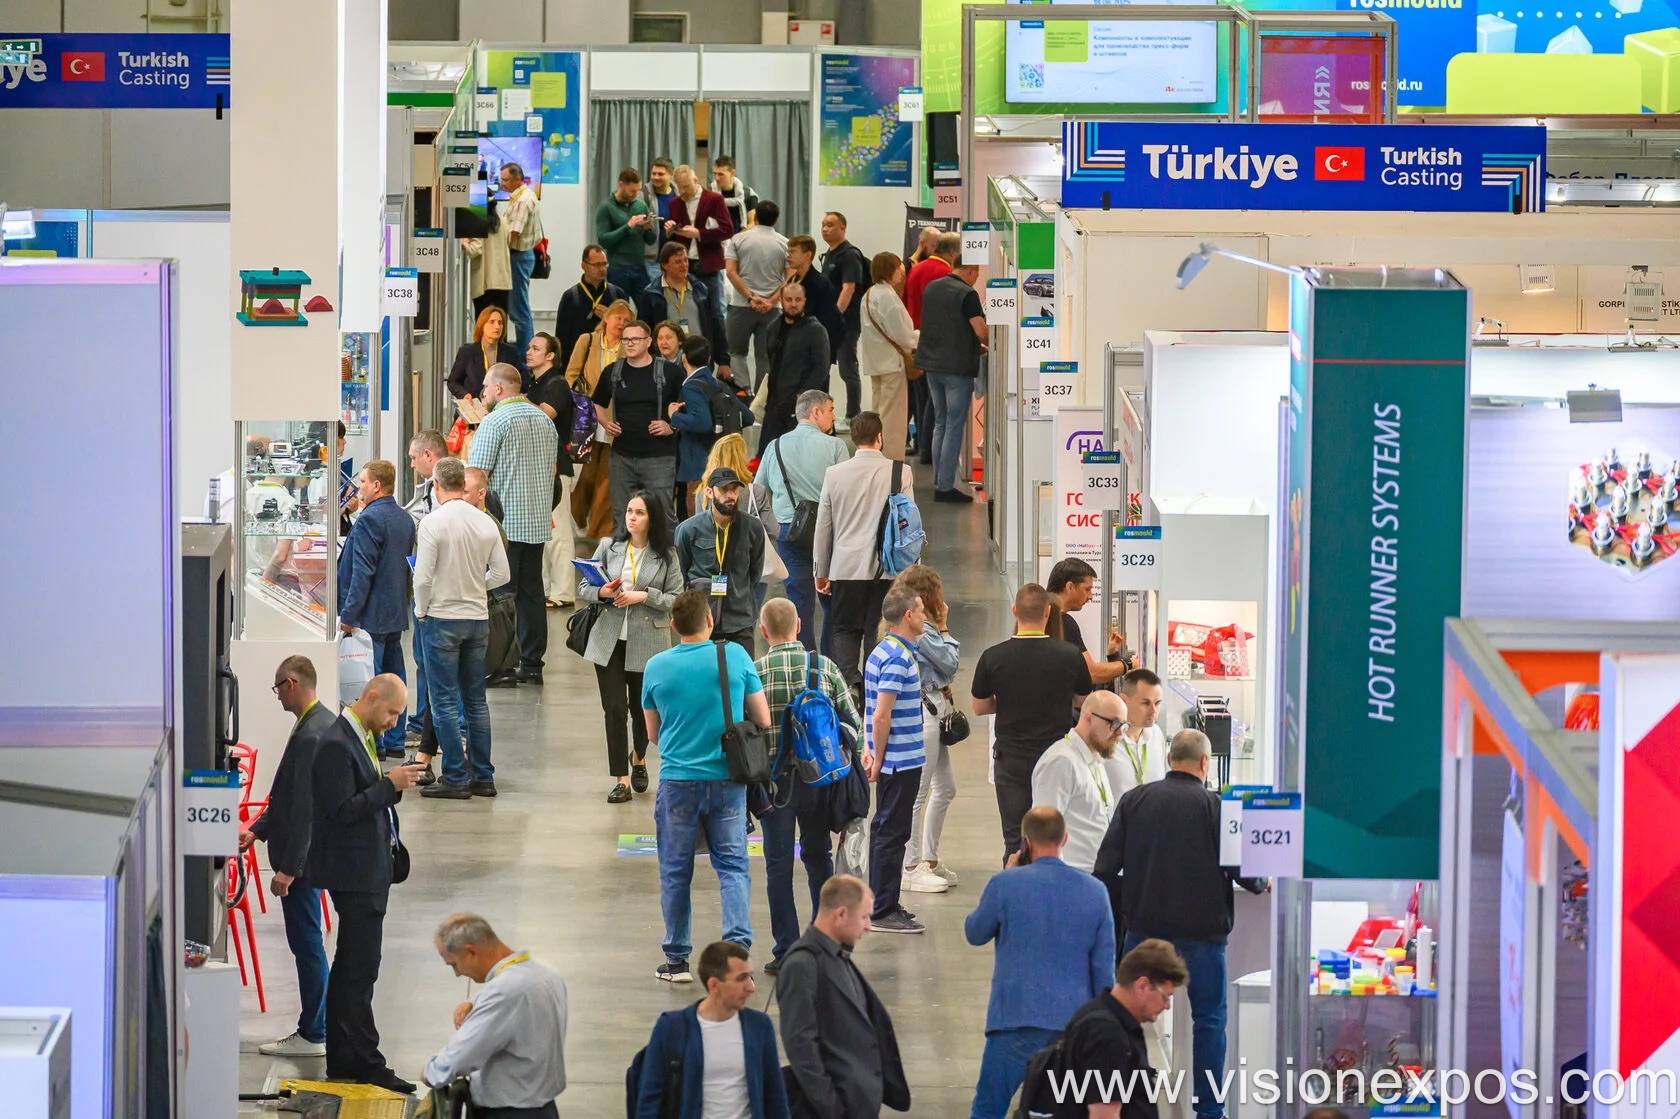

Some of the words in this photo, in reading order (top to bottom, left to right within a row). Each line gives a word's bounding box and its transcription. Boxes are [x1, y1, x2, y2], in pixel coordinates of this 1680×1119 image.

[118, 51, 190, 68] Turkish
[0, 59, 48, 90] ye
[119, 69, 191, 90] Casting
[1380, 146, 1463, 166] Turkish
[1142, 144, 1299, 189] Türkiye
[1381, 167, 1463, 191] Casting
[445, 184, 467, 193] 3C52
[938, 195, 958, 204] 3C51
[416, 247, 440, 257] 3C48
[965, 240, 988, 250] 3C47
[387, 288, 413, 299] 3C38
[990, 299, 1015, 309] 3C45
[1026, 339, 1052, 350] 3C41
[1044, 385, 1072, 396] 3C37
[1371, 403, 1402, 531] SYSTEMS
[1087, 477, 1119, 489] 3C33
[1121, 554, 1155, 567] 3C29
[1369, 535, 1399, 655] RUNNER
[1368, 657, 1396, 722] HOT
[187, 807, 231, 823] 3C26
[1251, 830, 1291, 845] 3C21
